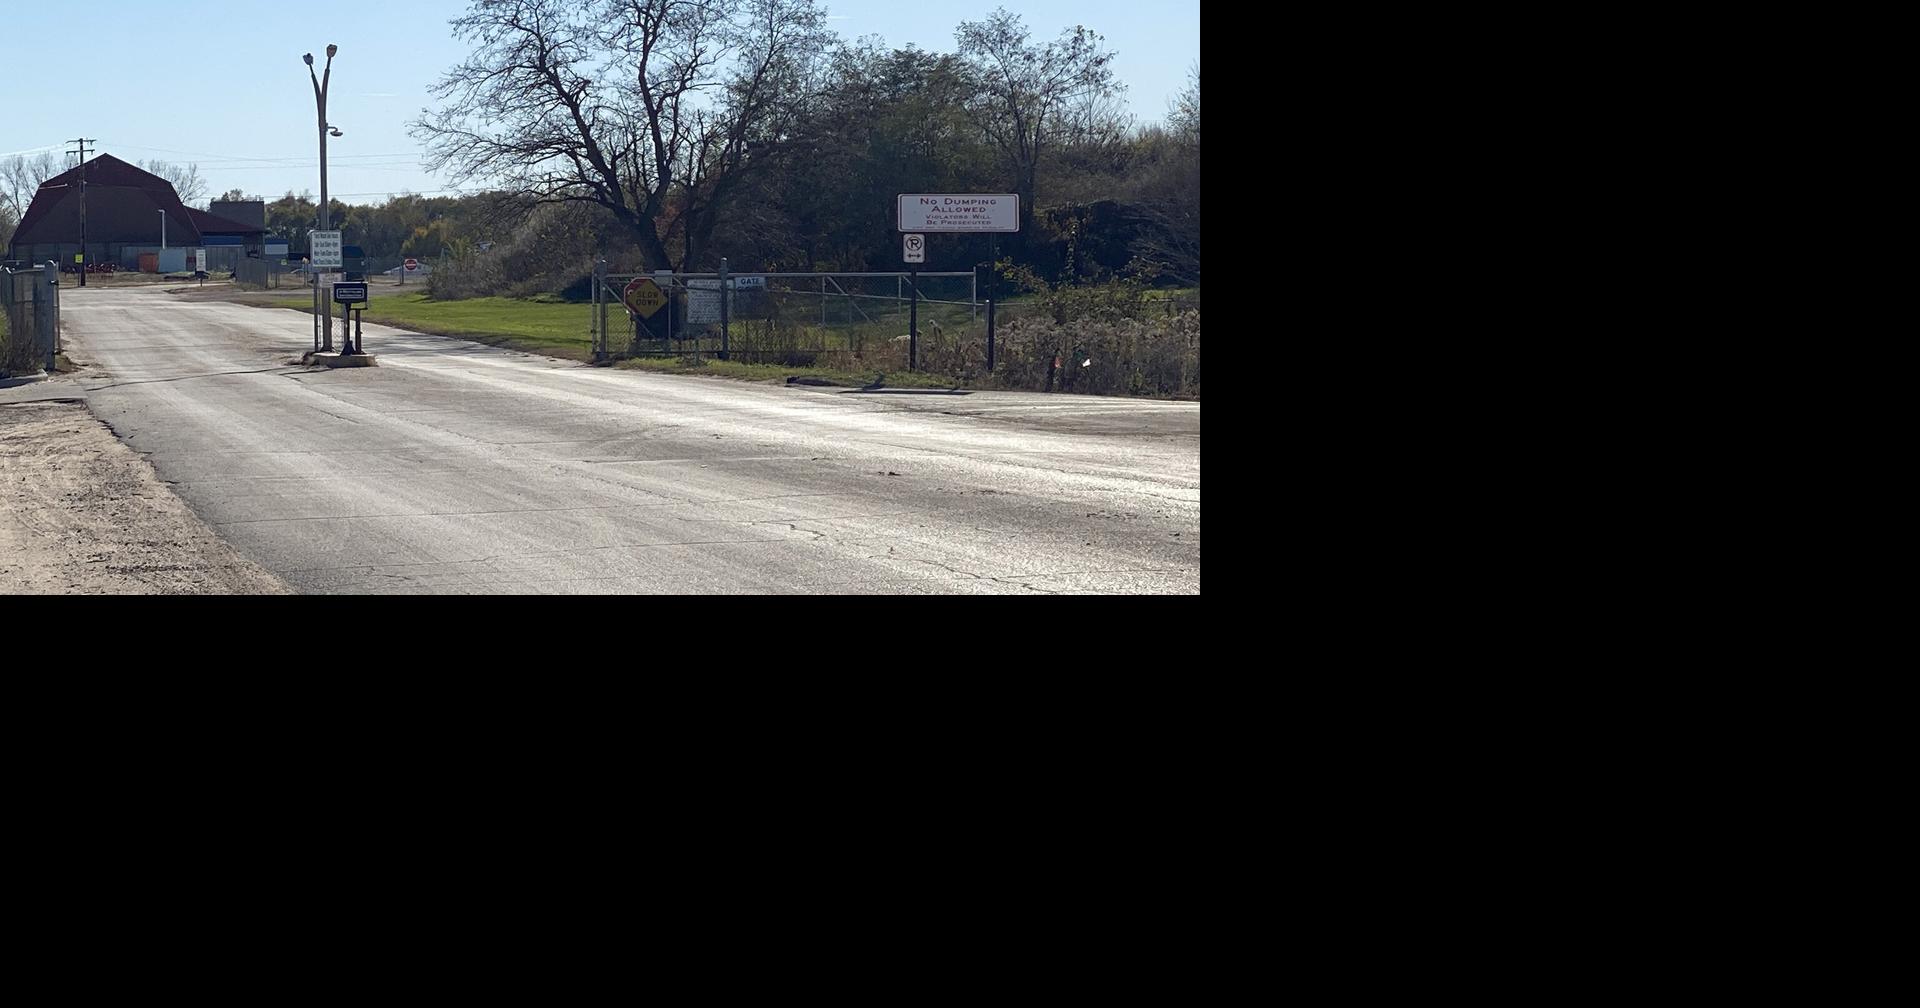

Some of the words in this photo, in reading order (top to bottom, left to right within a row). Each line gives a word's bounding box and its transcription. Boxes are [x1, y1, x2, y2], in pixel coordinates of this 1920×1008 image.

[944, 197, 997, 205] DUMPING
[931, 205, 986, 213] ALLOWED
[636, 290, 658, 298] SLOW
[635, 298, 659, 306] DOWN
